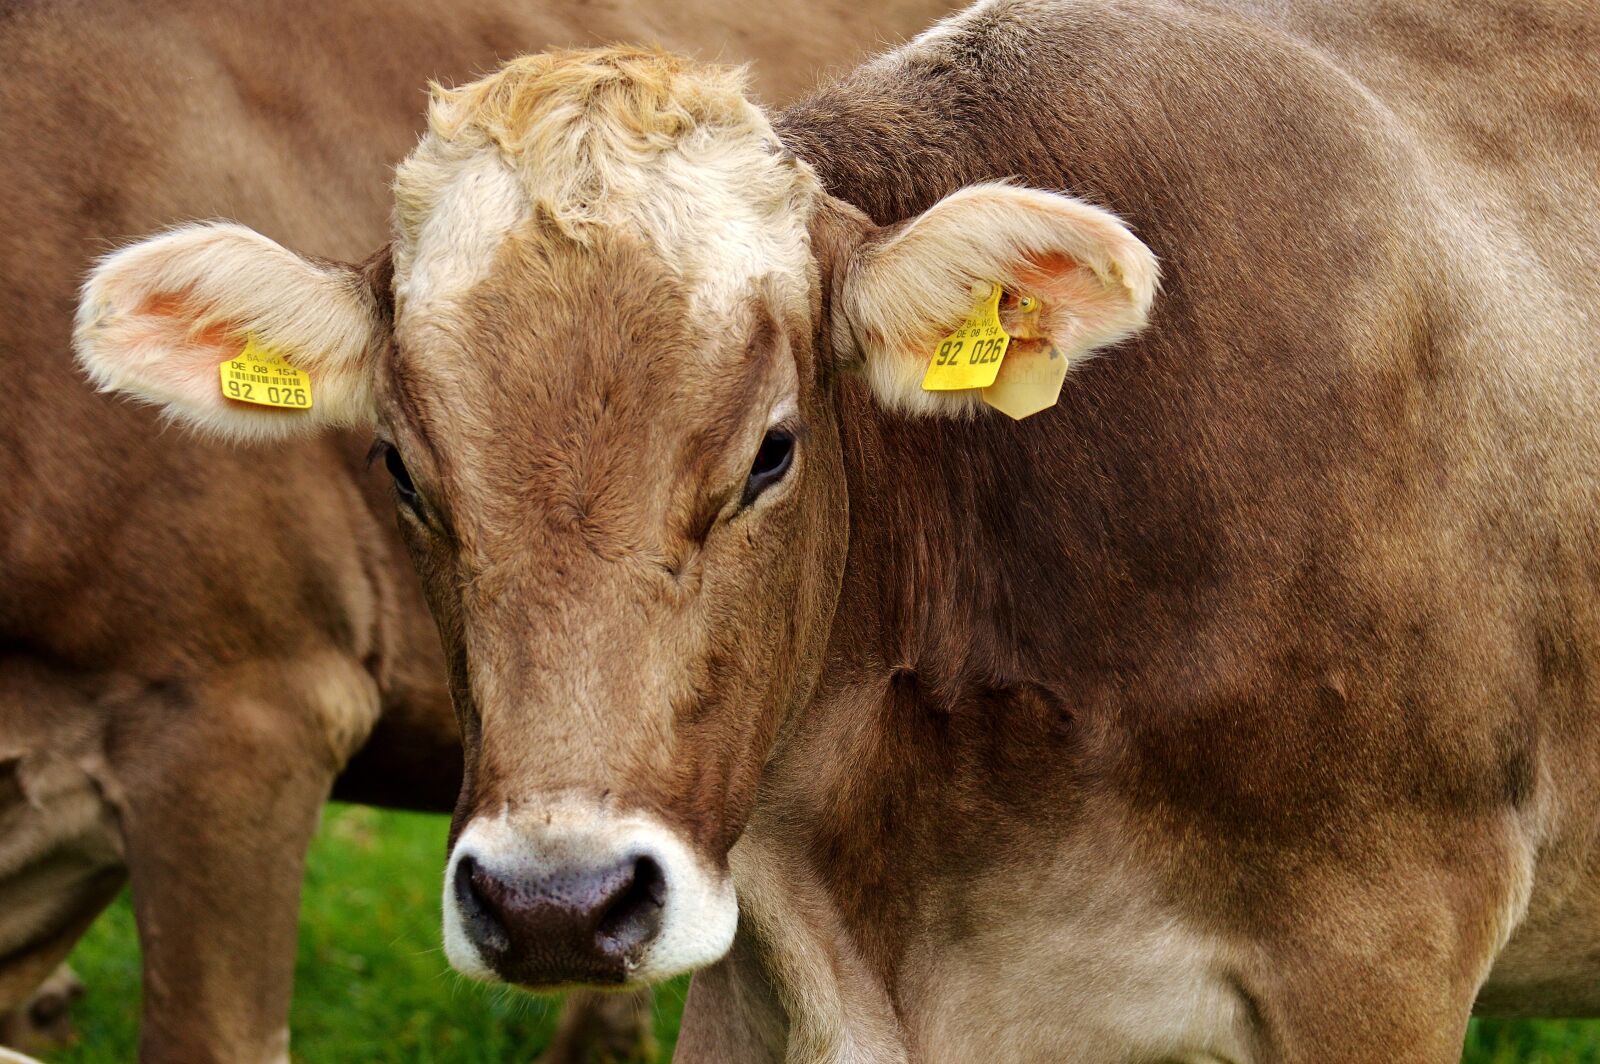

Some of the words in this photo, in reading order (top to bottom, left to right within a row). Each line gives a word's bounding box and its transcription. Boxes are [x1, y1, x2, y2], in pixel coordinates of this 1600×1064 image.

[956, 329, 967, 338] DE
[971, 329, 980, 338] 08
[985, 327, 998, 336] 154
[936, 341, 963, 366] 92
[969, 337, 1004, 365] 026
[231, 361, 246, 371] DE
[253, 365, 268, 374] 08
[275, 368, 297, 376] 154
[228, 381, 255, 400] 92
[268, 387, 307, 406] 026
